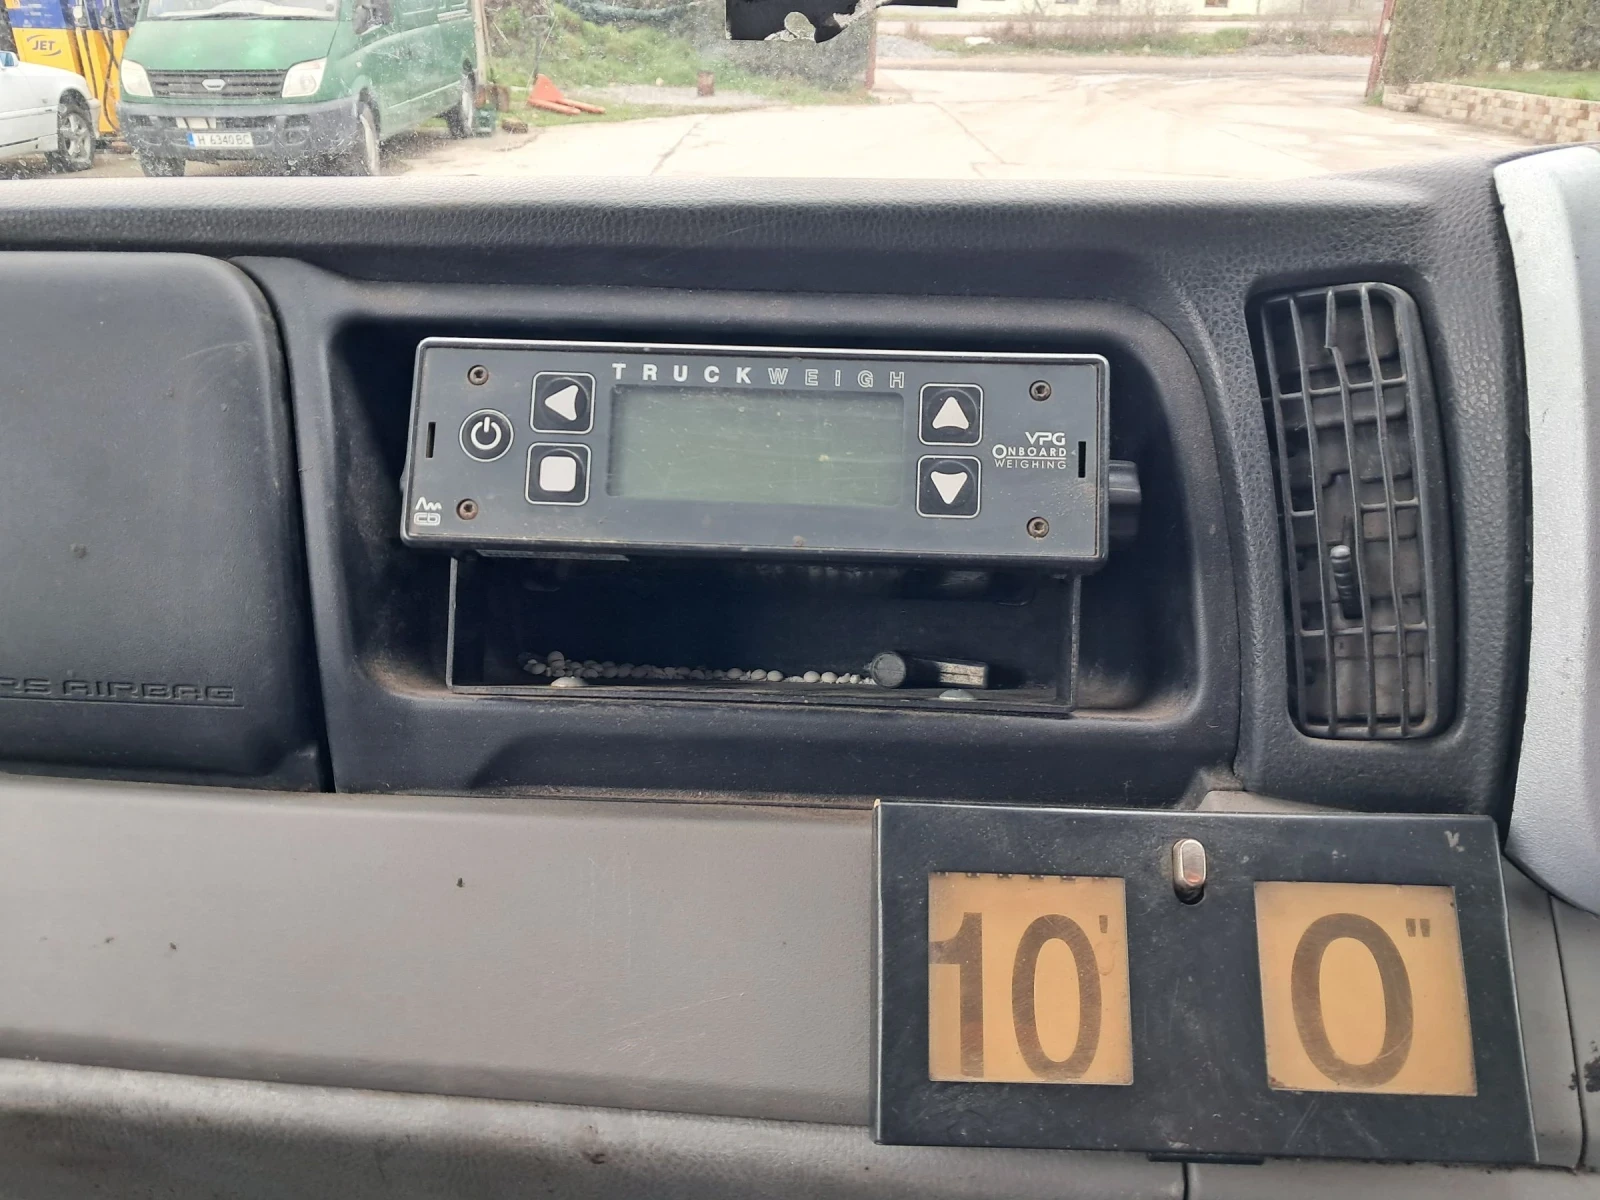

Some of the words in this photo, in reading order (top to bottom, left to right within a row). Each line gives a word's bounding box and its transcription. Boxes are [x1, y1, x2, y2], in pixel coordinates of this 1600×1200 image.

[32, 40, 56, 51] JET
[1024, 431, 1066, 446] VPG
[992, 444, 1067, 459] ONBOARD
[993, 458, 1067, 470] WEIGHING
[62, 679, 235, 701] AIRBAG
